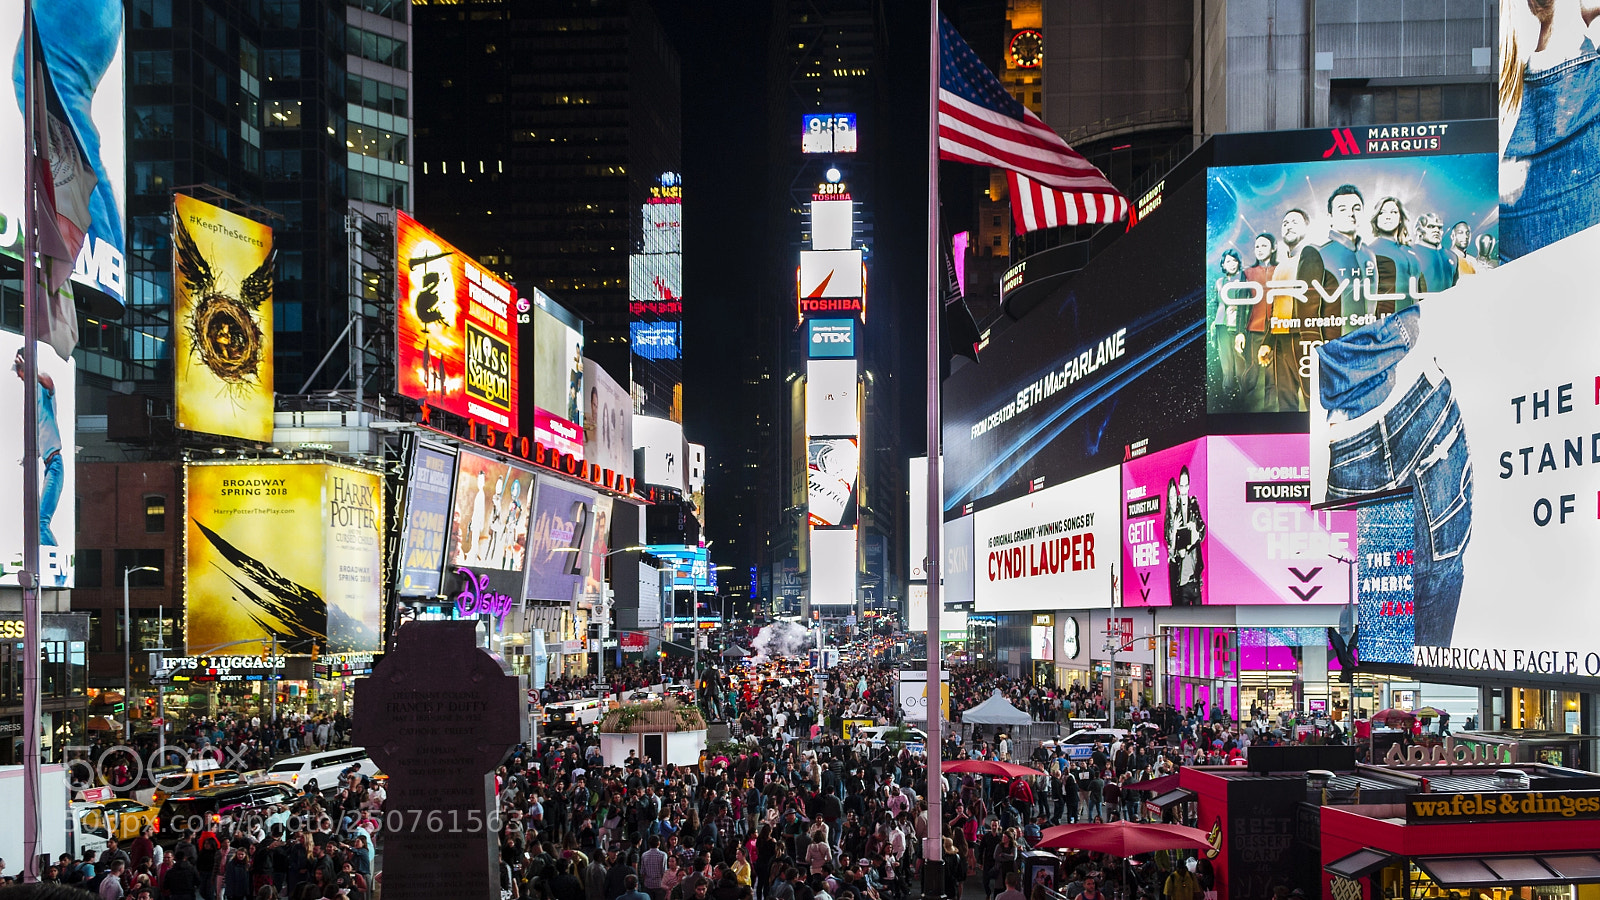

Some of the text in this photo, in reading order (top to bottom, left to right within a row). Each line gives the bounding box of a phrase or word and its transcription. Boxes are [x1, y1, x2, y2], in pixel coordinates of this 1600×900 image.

[1368, 124, 1449, 138] MARRIOTT
[1368, 138, 1439, 152] MARQUIS
[818, 183, 846, 194] 2017
[1138, 180, 1165, 208] MARRIOTT
[1138, 195, 1162, 220] MARQUIS
[189, 214, 264, 249] #KeepTheSecrets
[1338, 267, 1374, 277] THE
[801, 299, 861, 311] TOSHIBA
[517, 313, 530, 324] LG
[1270, 316, 1301, 329] From
[1304, 315, 1348, 328] creator
[820, 332, 852, 343] TDK
[468, 357, 509, 402] Saigon
[971, 421, 987, 440] FROM
[987, 402, 1015, 431] CREATOR
[1016, 382, 1043, 415] SETH
[1511, 383, 1574, 425] THE
[468, 418, 529, 459] 1540
[536, 441, 636, 497] BROADWAY
[221, 488, 288, 496] SPRING 2018
[223, 479, 286, 487] BROADWAY
[1253, 485, 1310, 498] TOURIST
[333, 475, 376, 510] HARRY
[213, 507, 295, 516] HarryPotterThePlay.com
[1128, 498, 1159, 516] TOURIST PLAN
[1533, 493, 1575, 527] OF
[330, 501, 379, 532] POTTER
[412, 509, 445, 533] COME
[1251, 506, 1306, 532] GET
[993, 532, 1014, 548] ORIGINAL
[1013, 526, 1036, 543] GRAMMY
[1063, 514, 1085, 532] SONGS
[1085, 512, 1095, 528] BY
[1128, 519, 1156, 544] GET IT
[1133, 541, 1160, 568] HERE
[1266, 532, 1350, 560] HERE
[406, 548, 441, 570] AWAY
[948, 545, 968, 575] SKIN
[987, 532, 1096, 582] CYNDI LAUPER
[1366, 551, 1391, 567] THE
[1362, 575, 1413, 592] AMERIC
[1380, 601, 1414, 617] JEAN
[209, 656, 286, 669] LUGGAGE
[1416, 646, 1506, 671] AMERICAN
[1513, 649, 1579, 674] EAGLE
[386, 702, 434, 713] FRANCIS
[448, 701, 488, 712] DUFFY
[444, 727, 474, 735] PRIEST
[1235, 834, 1294, 850] DESSERT
[1241, 848, 1282, 863] CART
